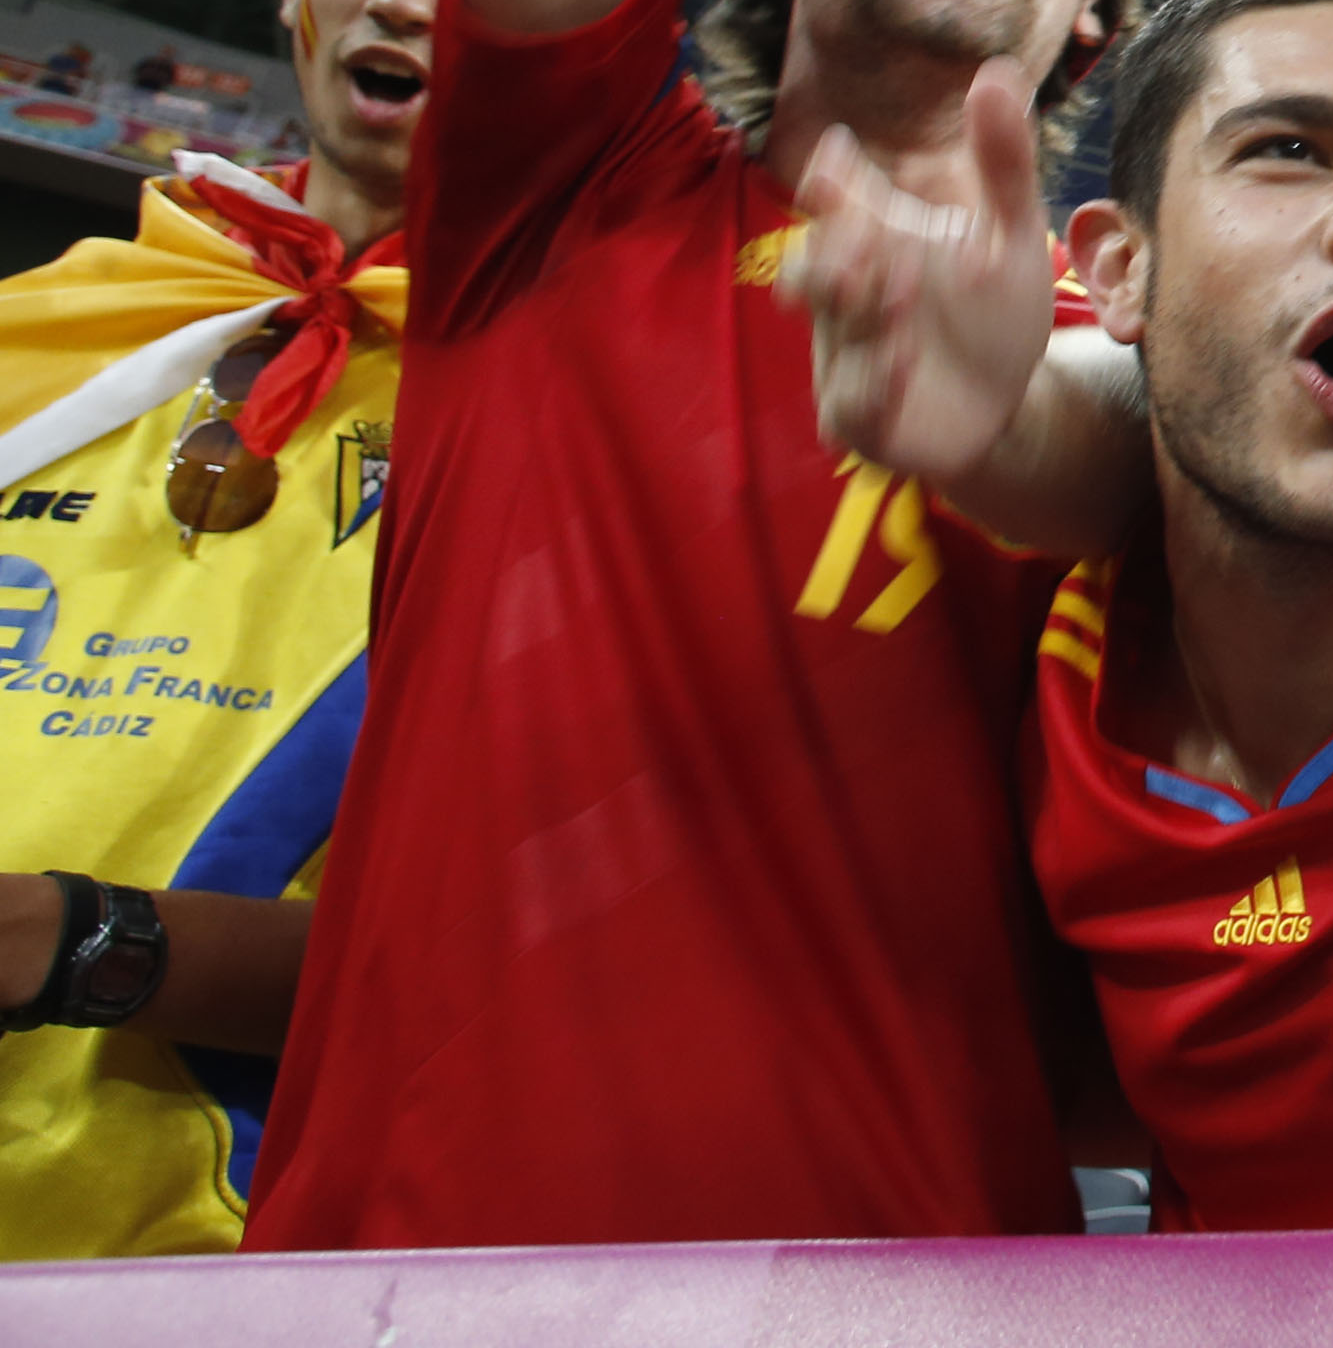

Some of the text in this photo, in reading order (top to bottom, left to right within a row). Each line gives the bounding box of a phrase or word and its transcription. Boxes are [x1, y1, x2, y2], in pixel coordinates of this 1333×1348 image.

[83, 631, 190, 657] GRUPO
[4, 660, 274, 711] ZONA FRANCA
[1213, 913, 1312, 946] adidas
